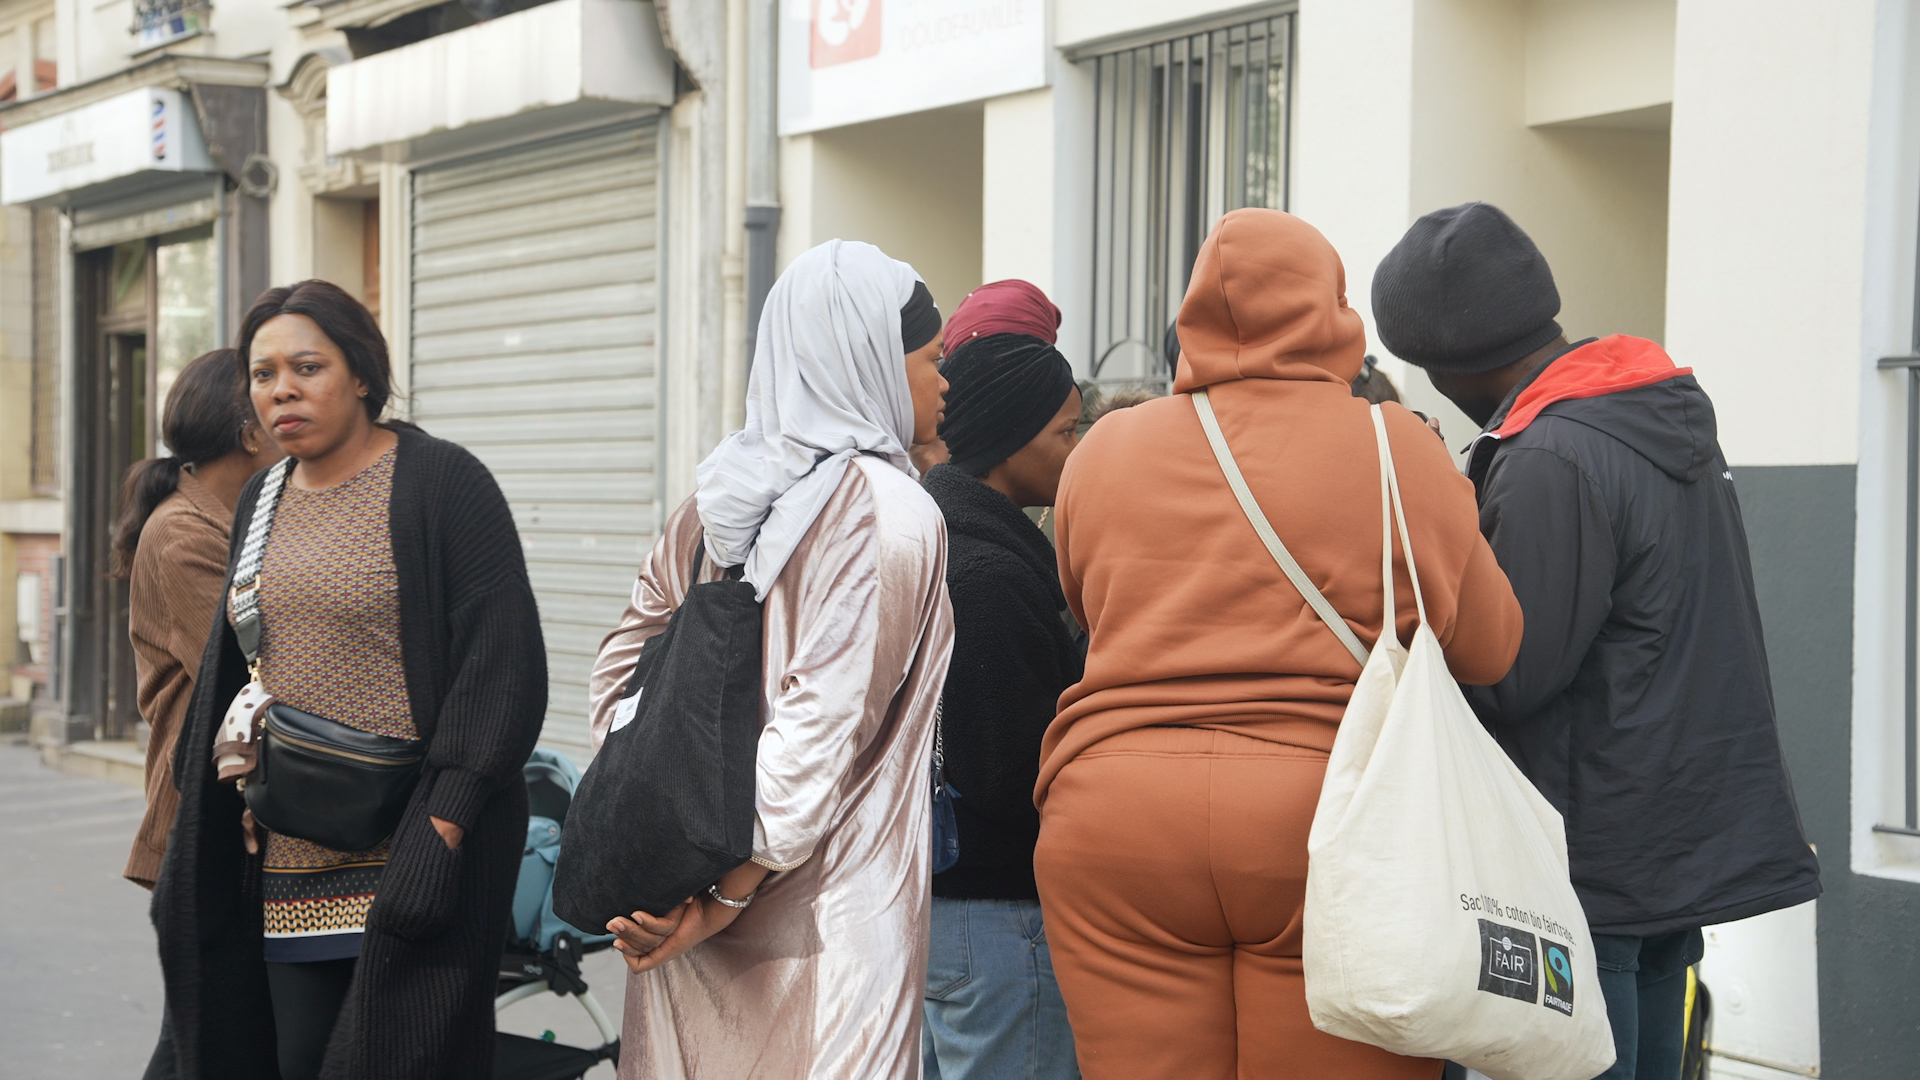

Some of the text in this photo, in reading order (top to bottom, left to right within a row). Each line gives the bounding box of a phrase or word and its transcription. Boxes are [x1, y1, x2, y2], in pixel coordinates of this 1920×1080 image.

[1460, 893, 1481, 911] Sac
[1505, 906, 1530, 925] coton
[1495, 950, 1524, 973] FAIR
[1545, 994, 1572, 1013] FAIRTRADE
